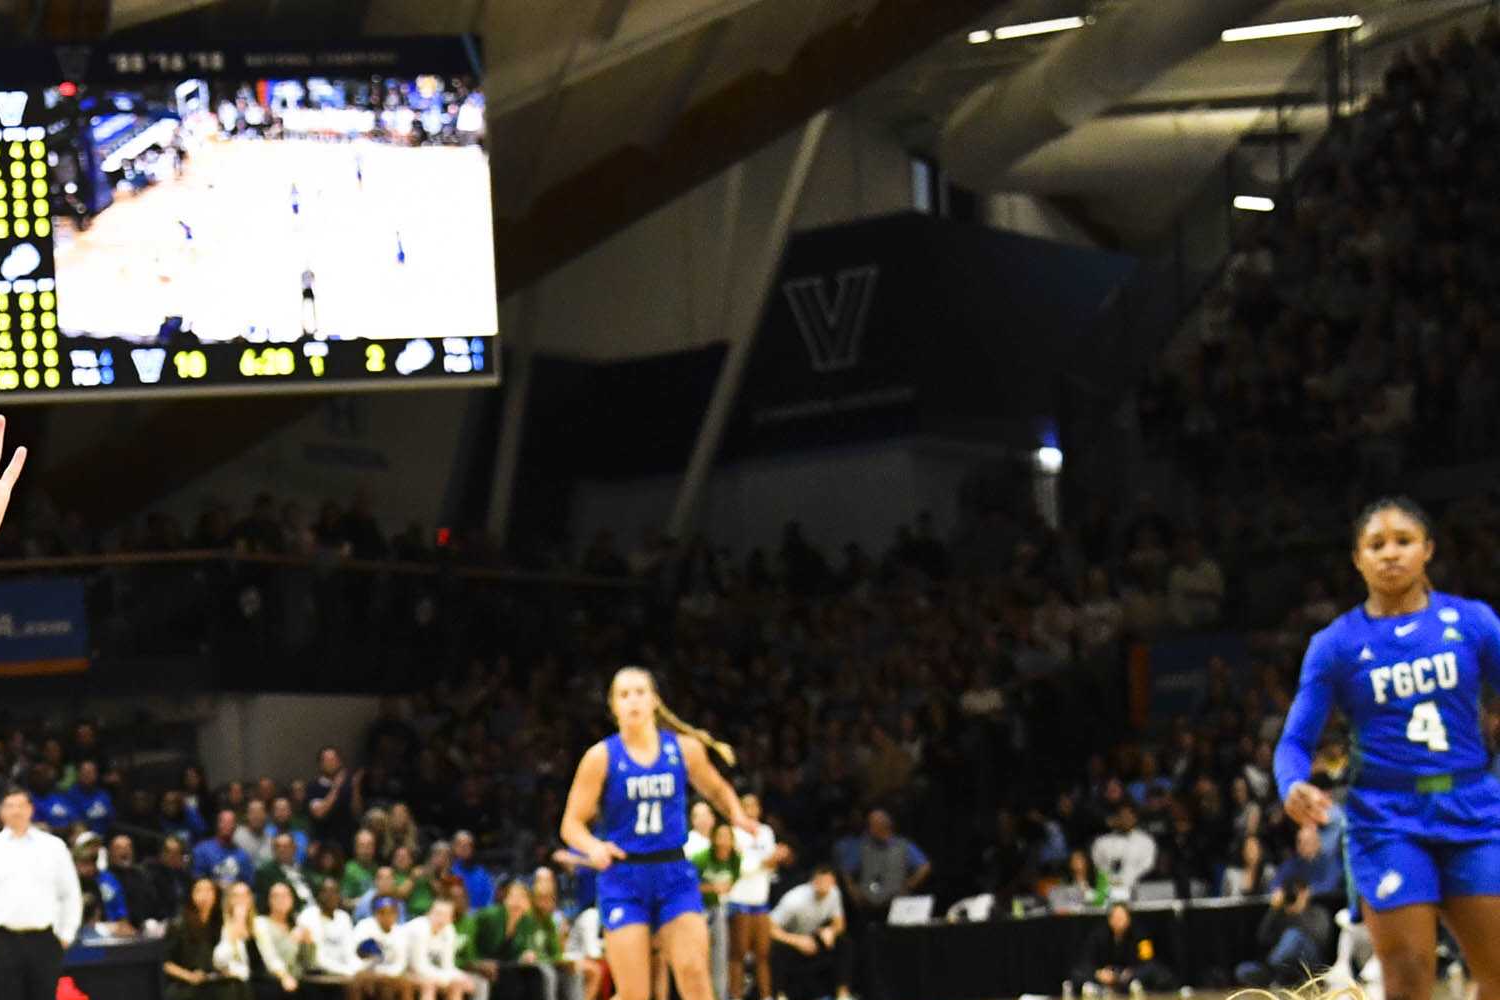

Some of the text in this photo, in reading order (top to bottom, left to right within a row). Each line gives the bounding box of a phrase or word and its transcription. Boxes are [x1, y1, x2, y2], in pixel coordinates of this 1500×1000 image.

[1369, 651, 1459, 705] FGCU
[1406, 701, 1449, 752] 4
[634, 801, 663, 835] 11
